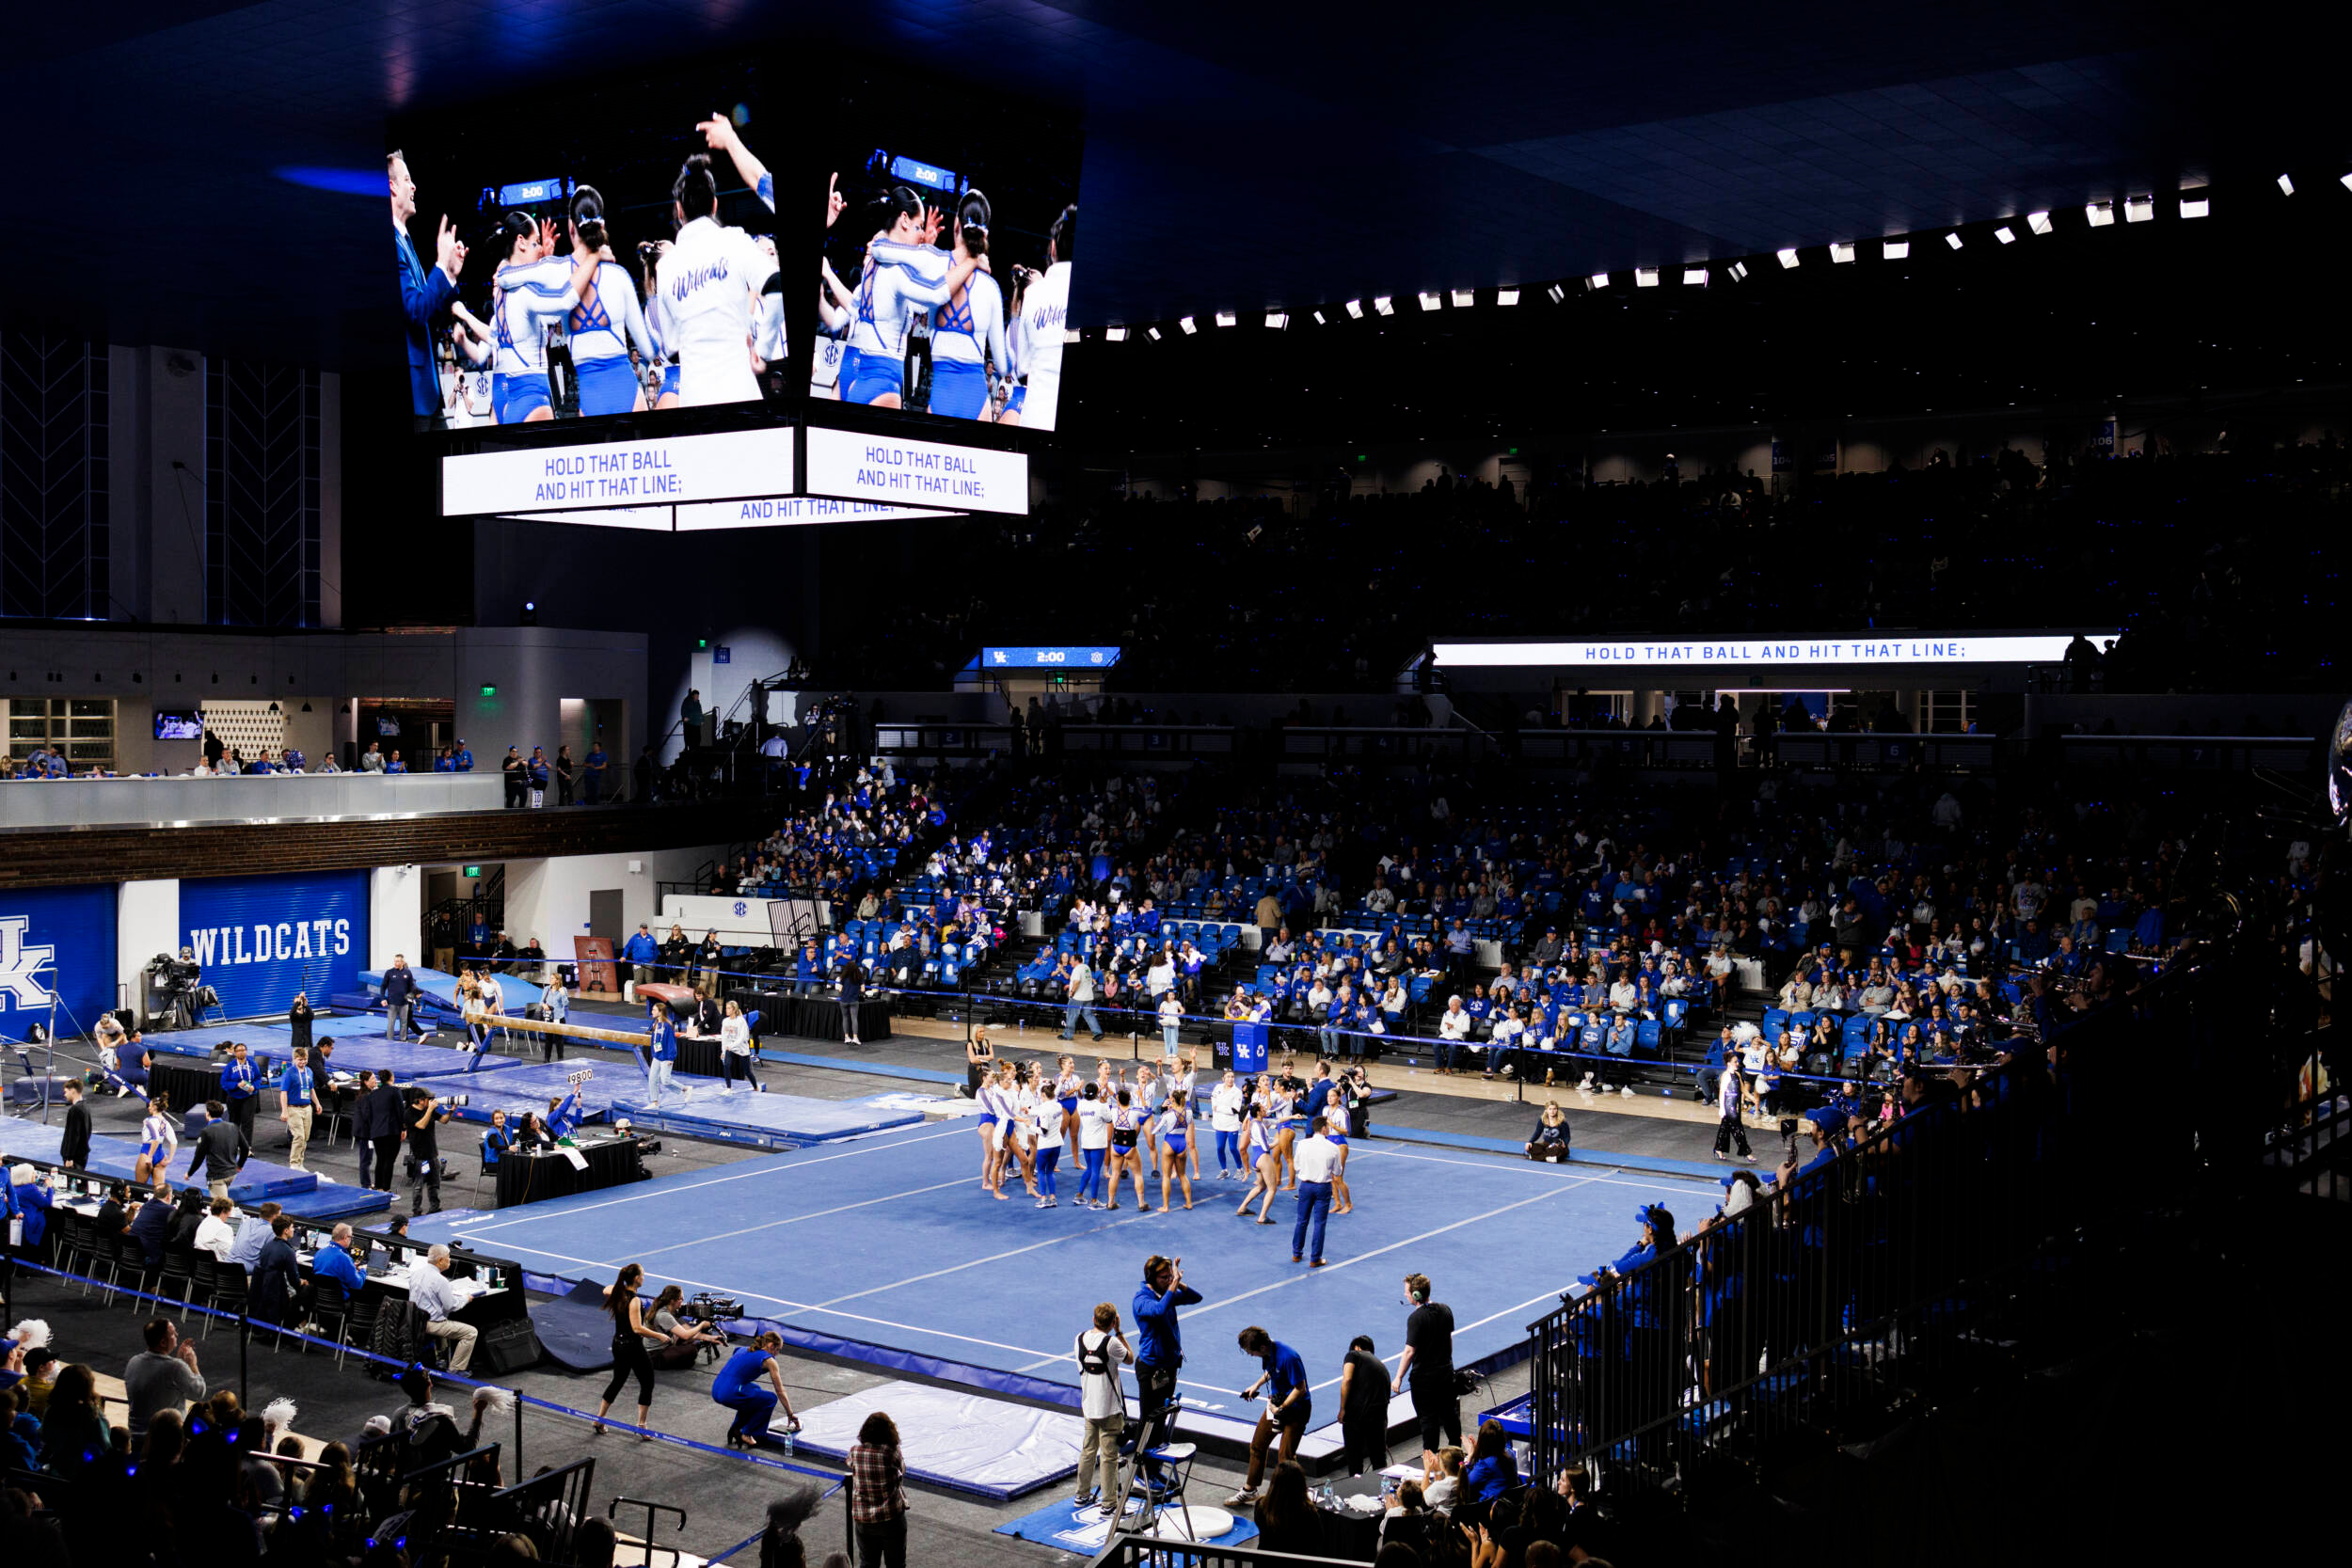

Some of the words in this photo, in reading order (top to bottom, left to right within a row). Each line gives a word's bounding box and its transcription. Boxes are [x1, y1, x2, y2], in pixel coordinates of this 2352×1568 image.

[915, 166, 938, 182] 2:00
[522, 185, 544, 198] 2:00
[672, 257, 729, 302] Wildcats
[825, 344, 839, 365] SEC
[477, 376, 489, 395] SEC
[546, 456, 585, 477] HOLD
[589, 453, 628, 472] THAT
[633, 450, 672, 469] BALL
[866, 447, 902, 465] HOLD
[907, 451, 941, 468] THAT
[945, 456, 977, 474] BALL
[535, 482, 565, 501] AND
[570, 480, 596, 499] HIT
[598, 477, 638, 497] THAT
[644, 473, 682, 495] LINE;
[857, 468, 885, 486] AND
[890, 473, 911, 489] HIT
[915, 475, 949, 492] THAT
[953, 480, 985, 499] LINE;
[740, 501, 772, 519] AND
[777, 499, 803, 516] HIT
[806, 498, 846, 515] THAT
[993, 651, 1008, 663] UK
[1037, 652, 1065, 662] 2:00
[1586, 647, 1635, 659] HOLD
[1645, 646, 1693, 659] THAT
[1704, 646, 1752, 659] BALL
[1761, 645, 1800, 658] AND
[1809, 645, 1841, 658] HIT
[1851, 644, 1902, 657] THAT
[1913, 643, 1966, 657] LINE;
[946, 733, 954, 742] 2
[734, 901, 747, 916] SEC
[190, 918, 350, 968] WILDCATS
[1216, 1041, 1230, 1056] UK
[1236, 1043, 1250, 1059] UK
